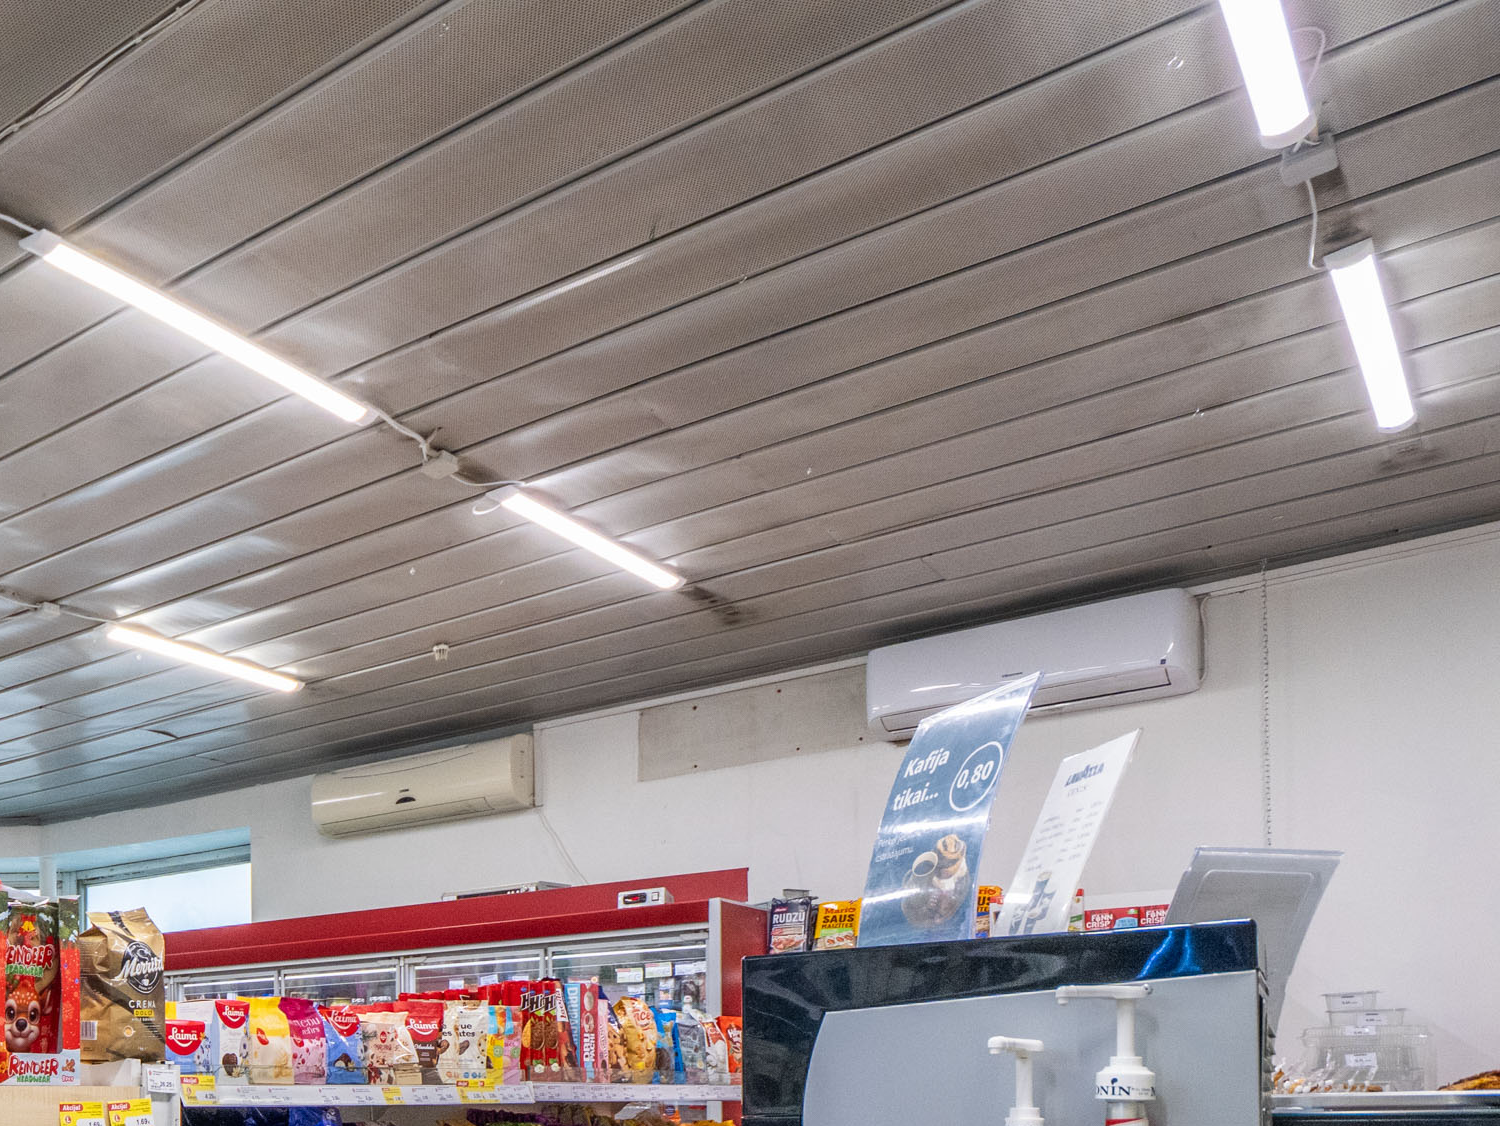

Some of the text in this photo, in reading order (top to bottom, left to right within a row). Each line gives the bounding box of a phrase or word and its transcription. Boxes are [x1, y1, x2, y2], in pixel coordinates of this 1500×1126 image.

[904, 748, 950, 778] Kafija
[957, 761, 995, 790] 0,80
[892, 783, 939, 811] tikai...
[823, 914, 855, 924] SAUS
[1086, 920, 1111, 929] CRISP
[5, 944, 54, 969] EINDEER
[222, 1005, 245, 1017] Laima
[407, 1018, 439, 1030] Laima
[168, 1026, 198, 1041] Laima
[8, 1055, 59, 1077] REINDEER
[16, 1074, 51, 1083] HEADWEAR
[111, 1103, 128, 1111] Akcija!
